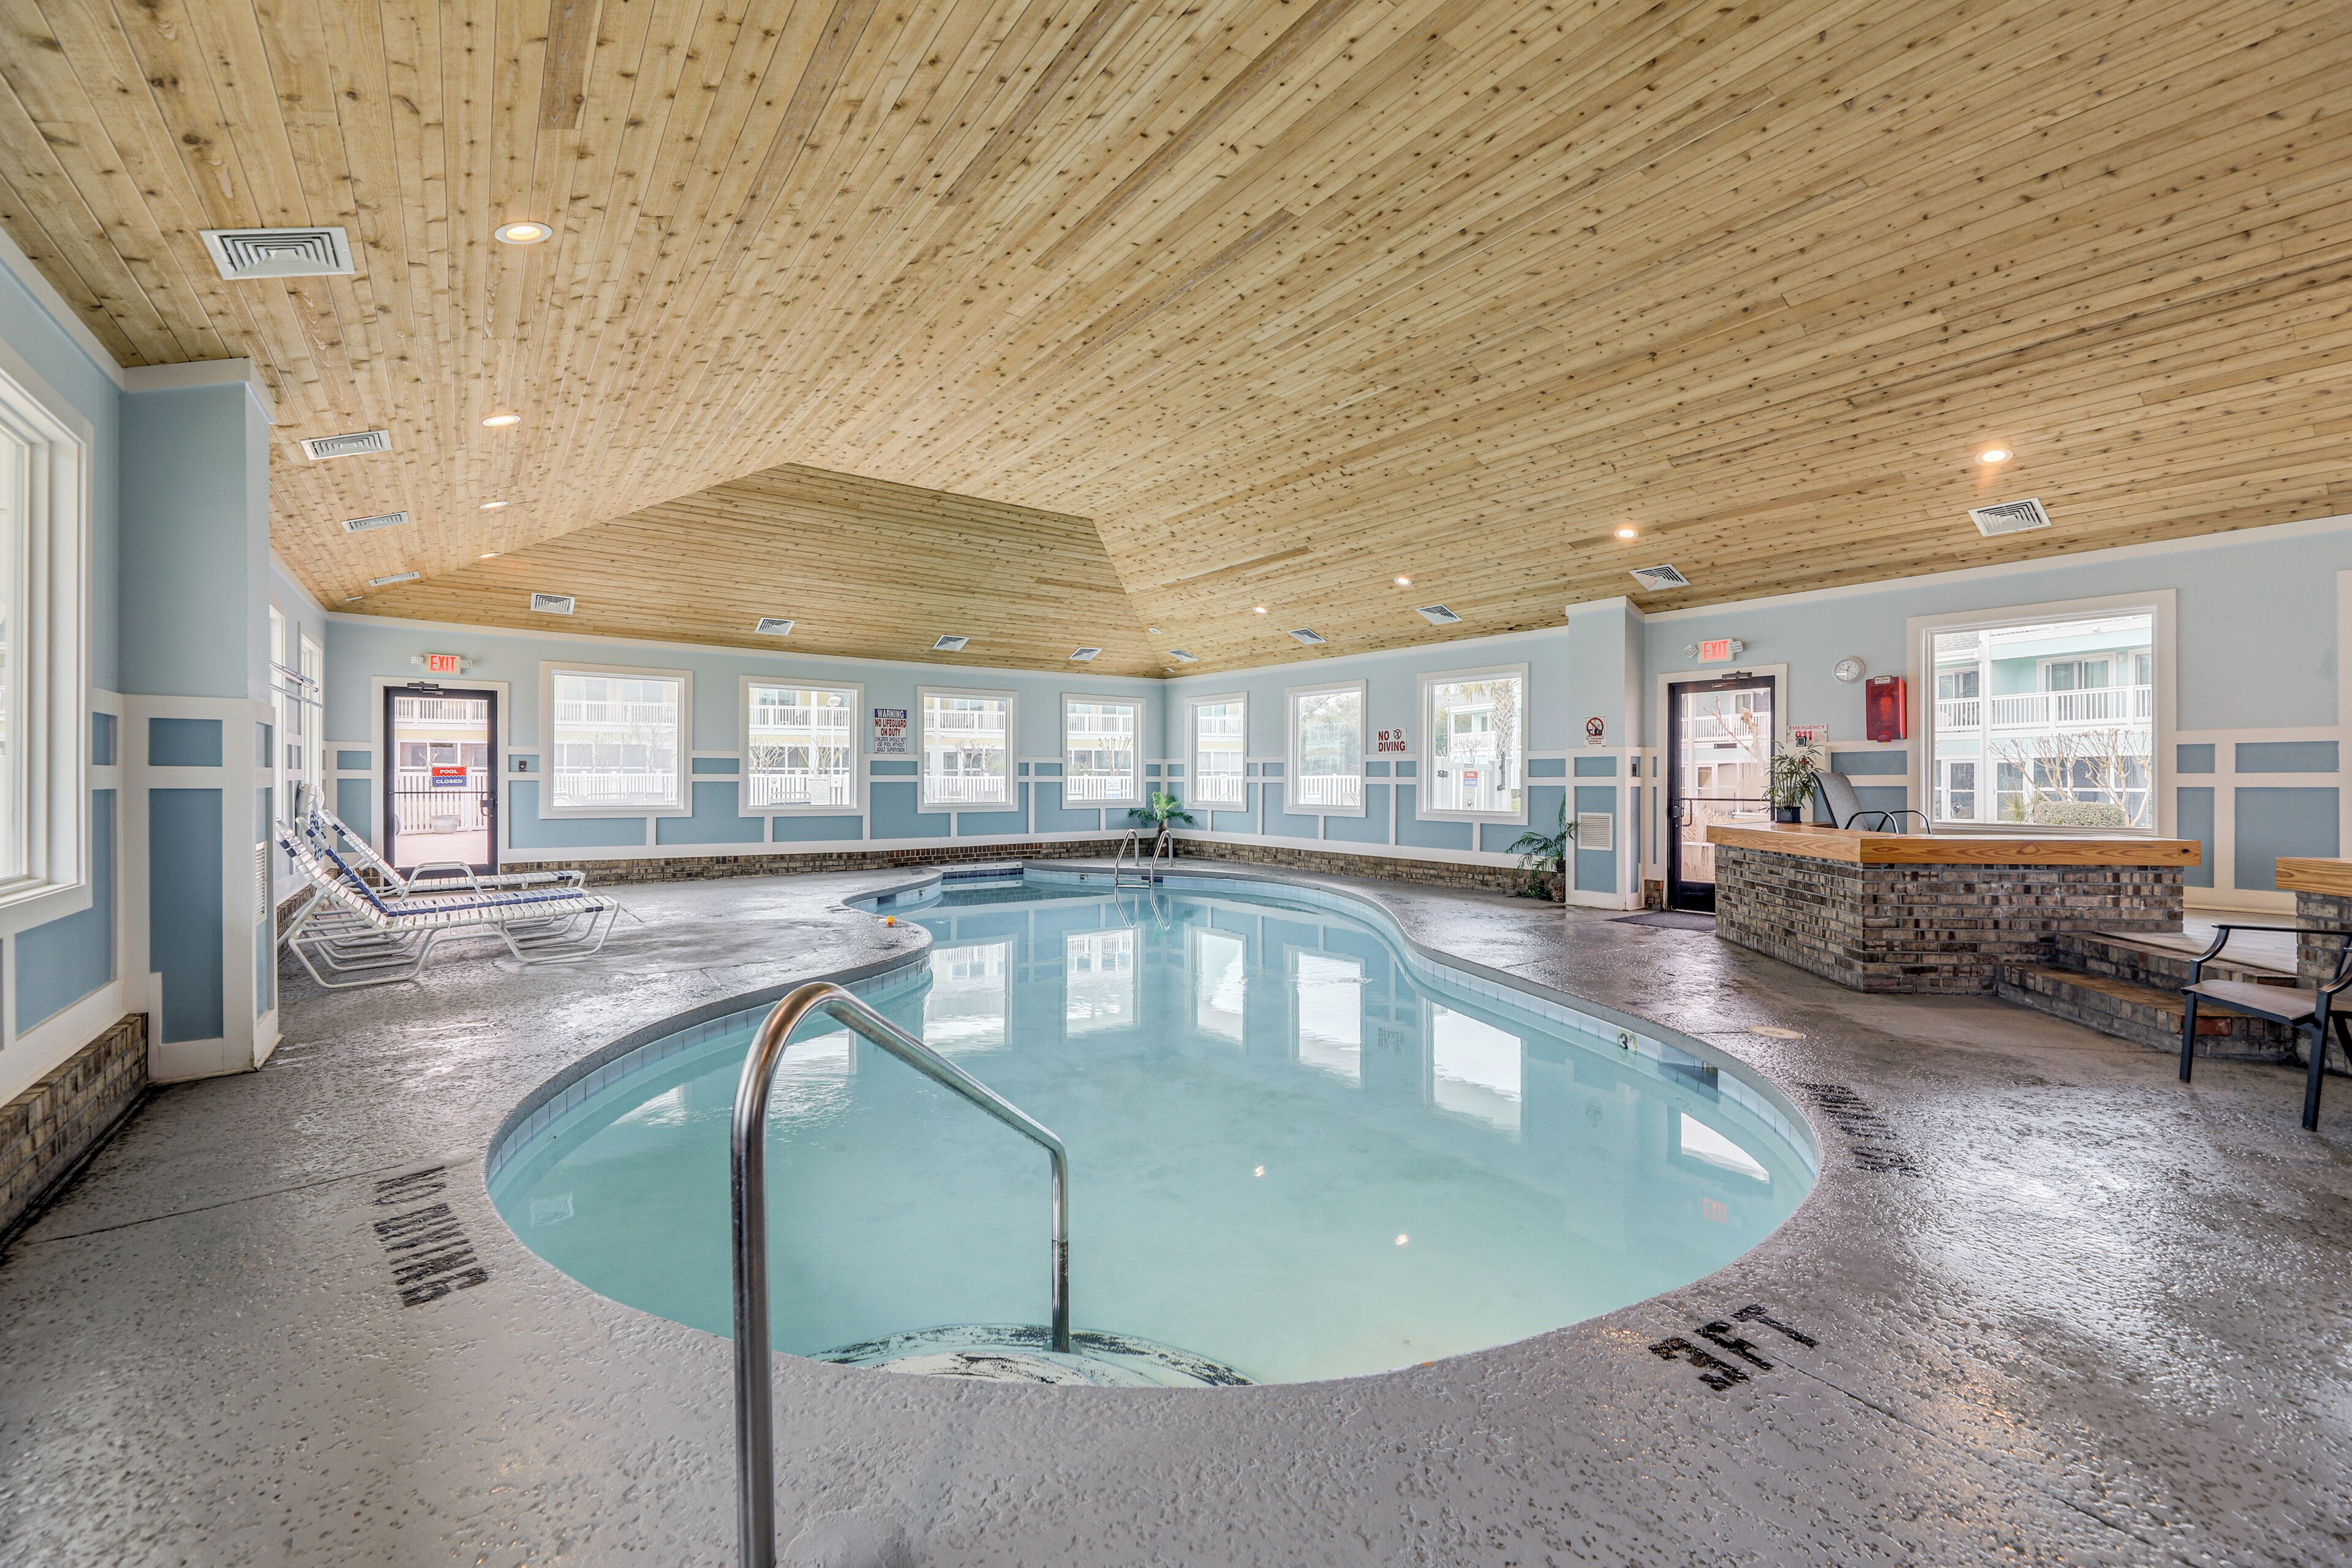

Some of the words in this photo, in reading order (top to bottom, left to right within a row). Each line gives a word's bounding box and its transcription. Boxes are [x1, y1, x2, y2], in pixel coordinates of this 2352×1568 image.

[1703, 641, 1728, 660] EXIT
[430, 655, 456, 672] EXIT
[877, 709, 904, 718] WARNING
[875, 718, 881, 727] NO
[883, 719, 907, 728] LIFEGUARD
[881, 728, 888, 736] ON
[889, 728, 900, 737] DUTY
[1379, 731, 1389, 741] NO
[1795, 730, 1812, 741] 911
[1379, 741, 1405, 752] DIVING
[1619, 1033, 1629, 1049] 3
[1629, 1036, 1637, 1045] FT
[1798, 1082, 1901, 1140] DIVING
[374, 1166, 447, 1206] NO
[373, 1202, 489, 1308] DIVING
